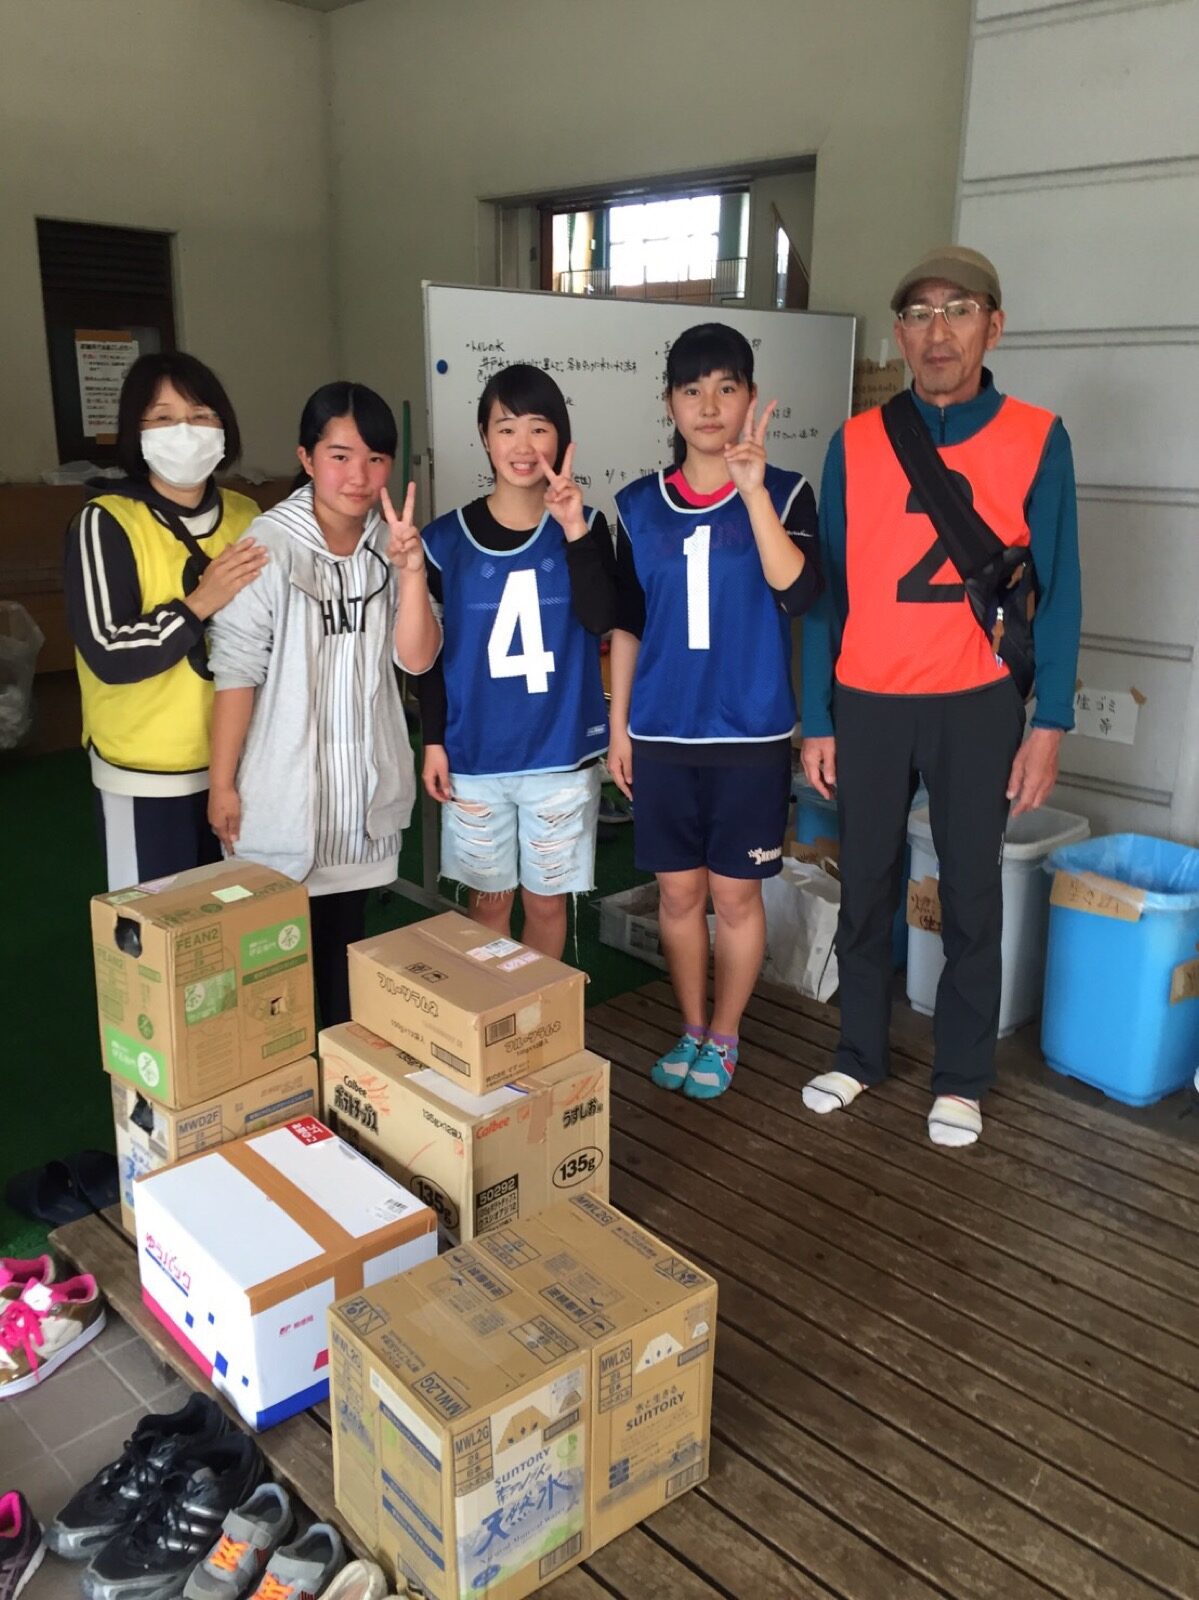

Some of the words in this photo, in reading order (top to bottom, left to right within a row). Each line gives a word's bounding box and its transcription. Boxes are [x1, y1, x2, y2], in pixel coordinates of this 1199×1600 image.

[896, 469, 974, 603] 2
[683, 525, 711, 649] 1
[487, 569, 555, 693] 4
[176, 928, 218, 951] FEAN2
[344, 1075, 367, 1098] Calbee
[178, 1111, 219, 1135] MWD2F
[476, 1116, 511, 1140] Calbee
[560, 1153, 596, 1181] 135g
[480, 1178, 516, 1205] 50292
[580, 1195, 613, 1223] MWL2G
[145, 1231, 192, 1291] ゆうパック
[601, 1346, 632, 1373] MWL2G
[420, 1375, 464, 1417] MWL2G
[626, 1392, 685, 1431] SUNTORY
[455, 1424, 489, 1455] MWL2G
[495, 1447, 551, 1487] SUNTORY
[474, 1473, 573, 1557] 天然水
